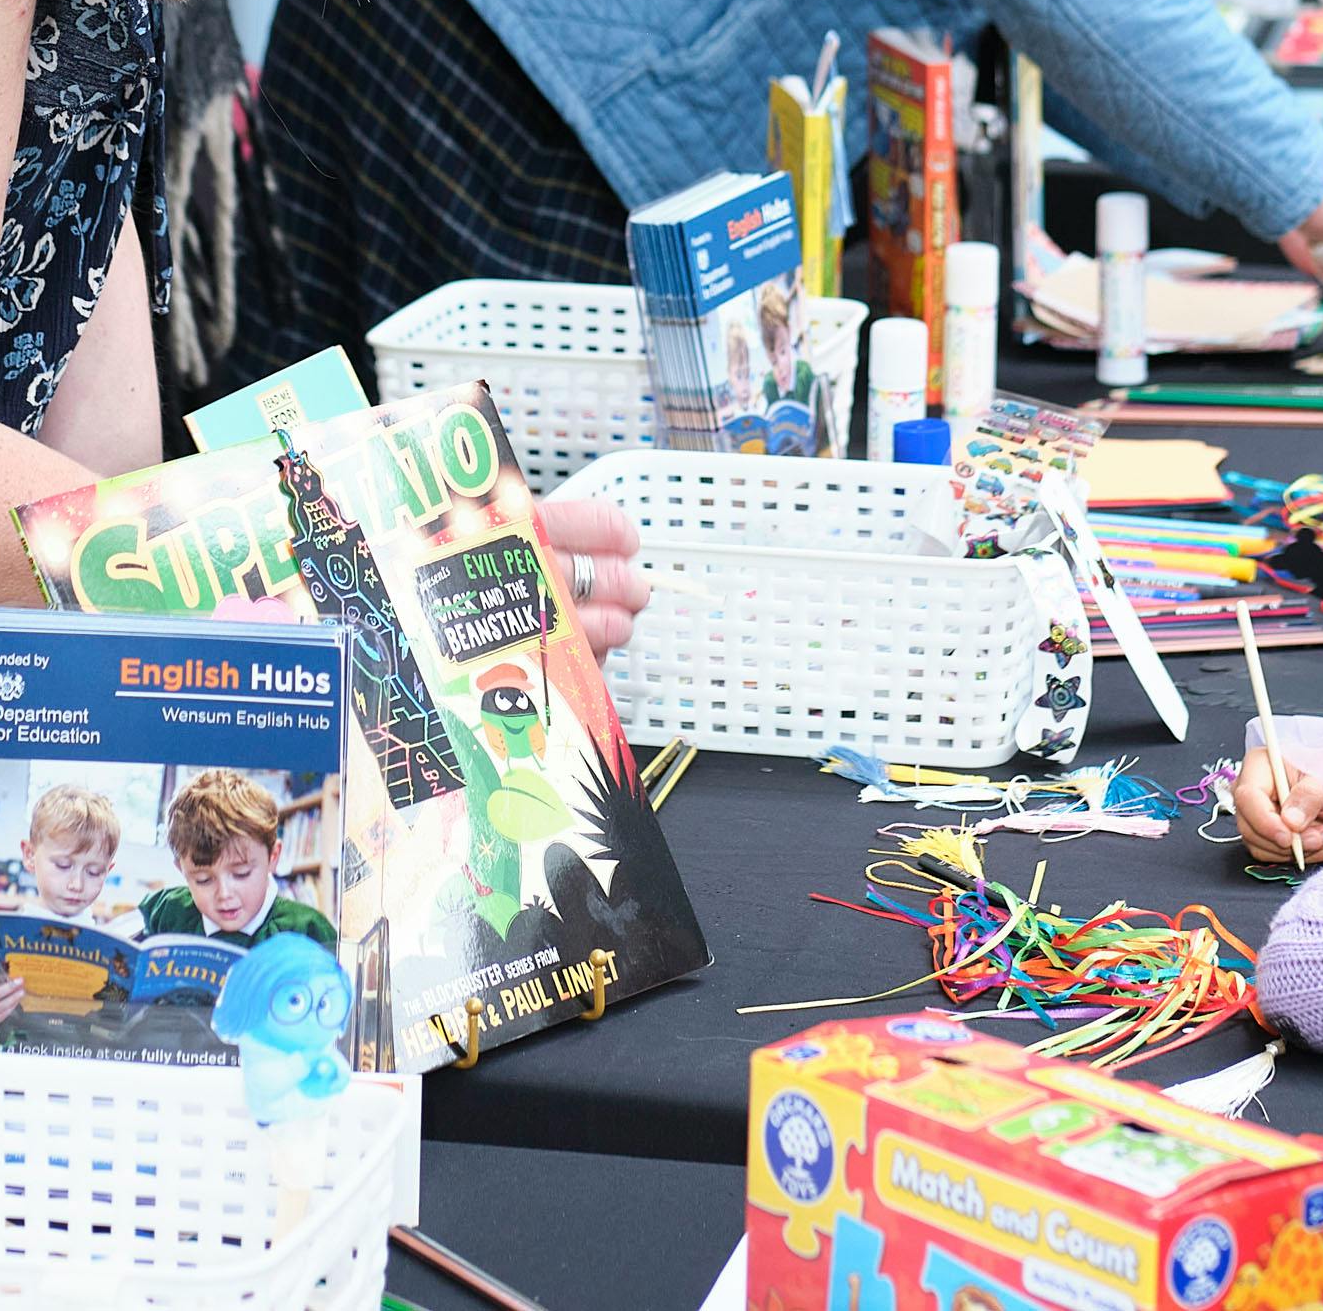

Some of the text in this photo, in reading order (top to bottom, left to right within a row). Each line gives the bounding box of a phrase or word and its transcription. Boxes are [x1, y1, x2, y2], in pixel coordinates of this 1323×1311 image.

[70, 402, 501, 616] SUPETATO
[462, 553, 502, 581] EVIL
[503, 548, 539, 576] PEA
[479, 586, 506, 610] AND
[504, 578, 530, 602] THE
[443, 604, 541, 656] BEANSTALK
[33, 653, 50, 670] by
[119, 657, 332, 695] English Hubs
[162, 706, 331, 731] Wensum English Hub
[17, 726, 101, 745] Education
[4, 934, 110, 965] Mammals
[424, 964, 505, 1012] BLOCKBUSTER
[505, 955, 536, 980] SERIES
[534, 946, 561, 970] FROM
[486, 1004, 503, 1028] &
[500, 977, 554, 1020] PAUL
[18, 1041, 49, 1056] look
[52, 1043, 92, 1059] inside
[96, 1047, 111, 1060] at
[114, 1049, 138, 1062] our
[141, 1048, 172, 1064] fully
[176, 1050, 227, 1066] funded
[890, 1149, 985, 1223] Match
[989, 1203, 1041, 1244] and
[1044, 1208, 1140, 1286] Count
